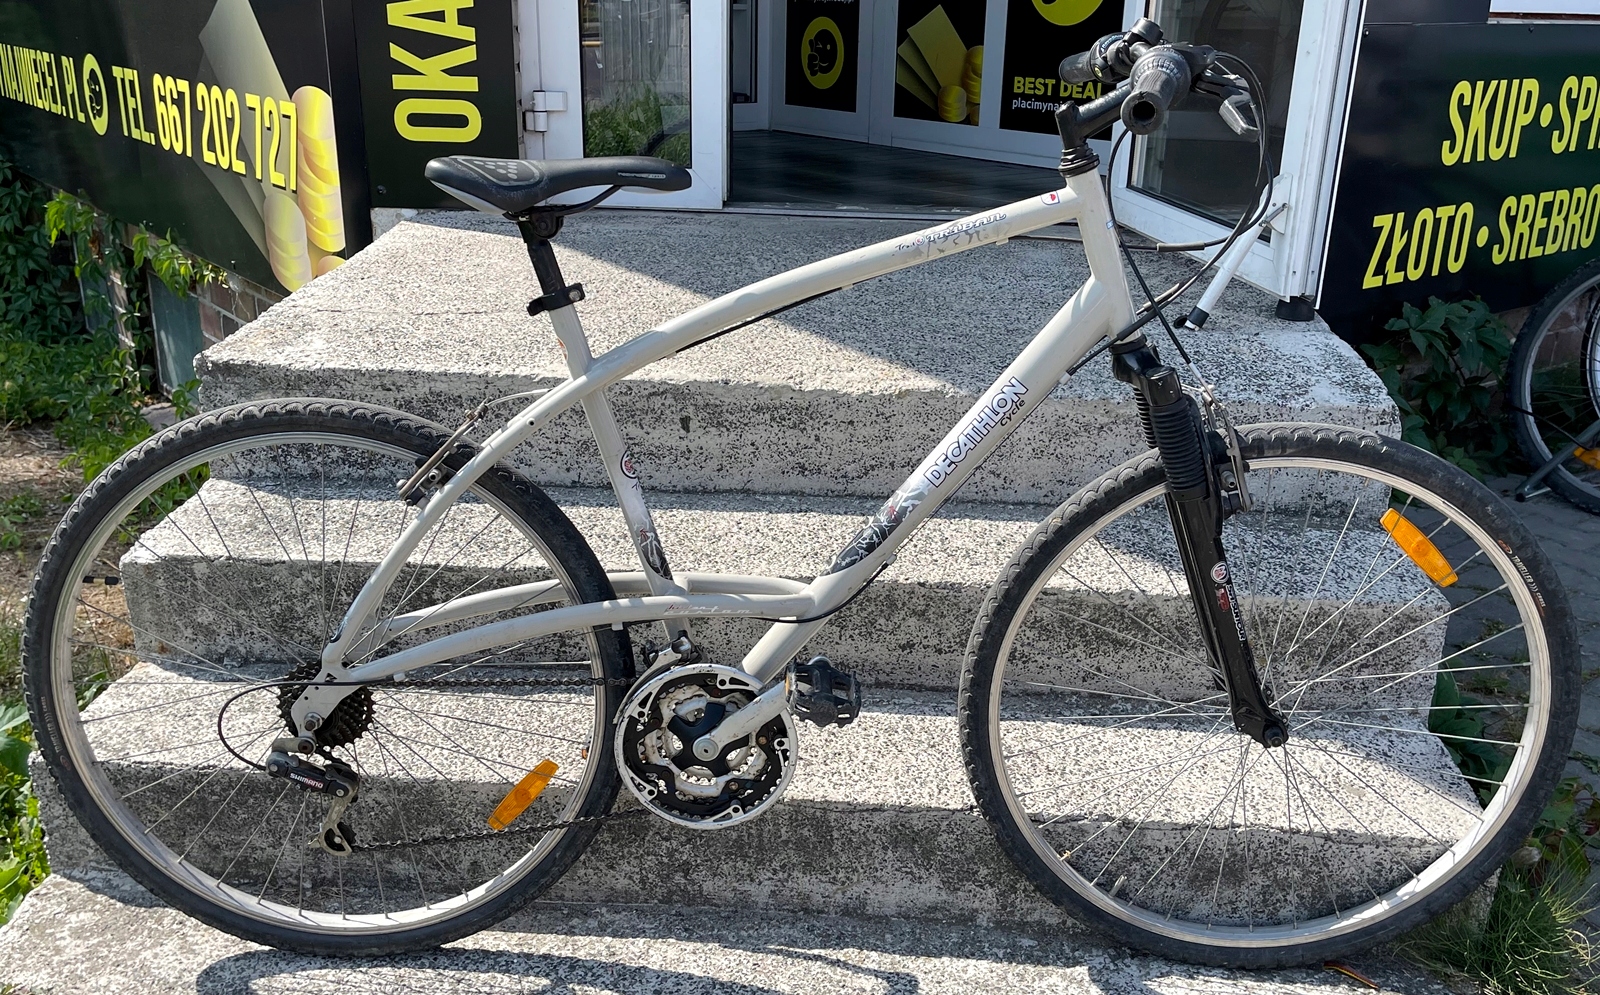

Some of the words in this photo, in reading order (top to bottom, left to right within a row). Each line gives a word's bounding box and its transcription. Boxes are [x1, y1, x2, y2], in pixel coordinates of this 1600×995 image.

[112, 65, 155, 146] TEL.
[153, 73, 194, 158] 667
[196, 82, 247, 176] 202
[246, 93, 298, 193] 727
[1013, 76, 1056, 96] BEST
[1441, 78, 1540, 166] SKUP
[1362, 202, 1474, 289] ZŁOTO
[1492, 184, 1600, 265] SREBRO
[923, 376, 1029, 488] DECATHLON
[1000, 399, 1026, 427] Cycle
[290, 772, 324, 789] SHIMANO
